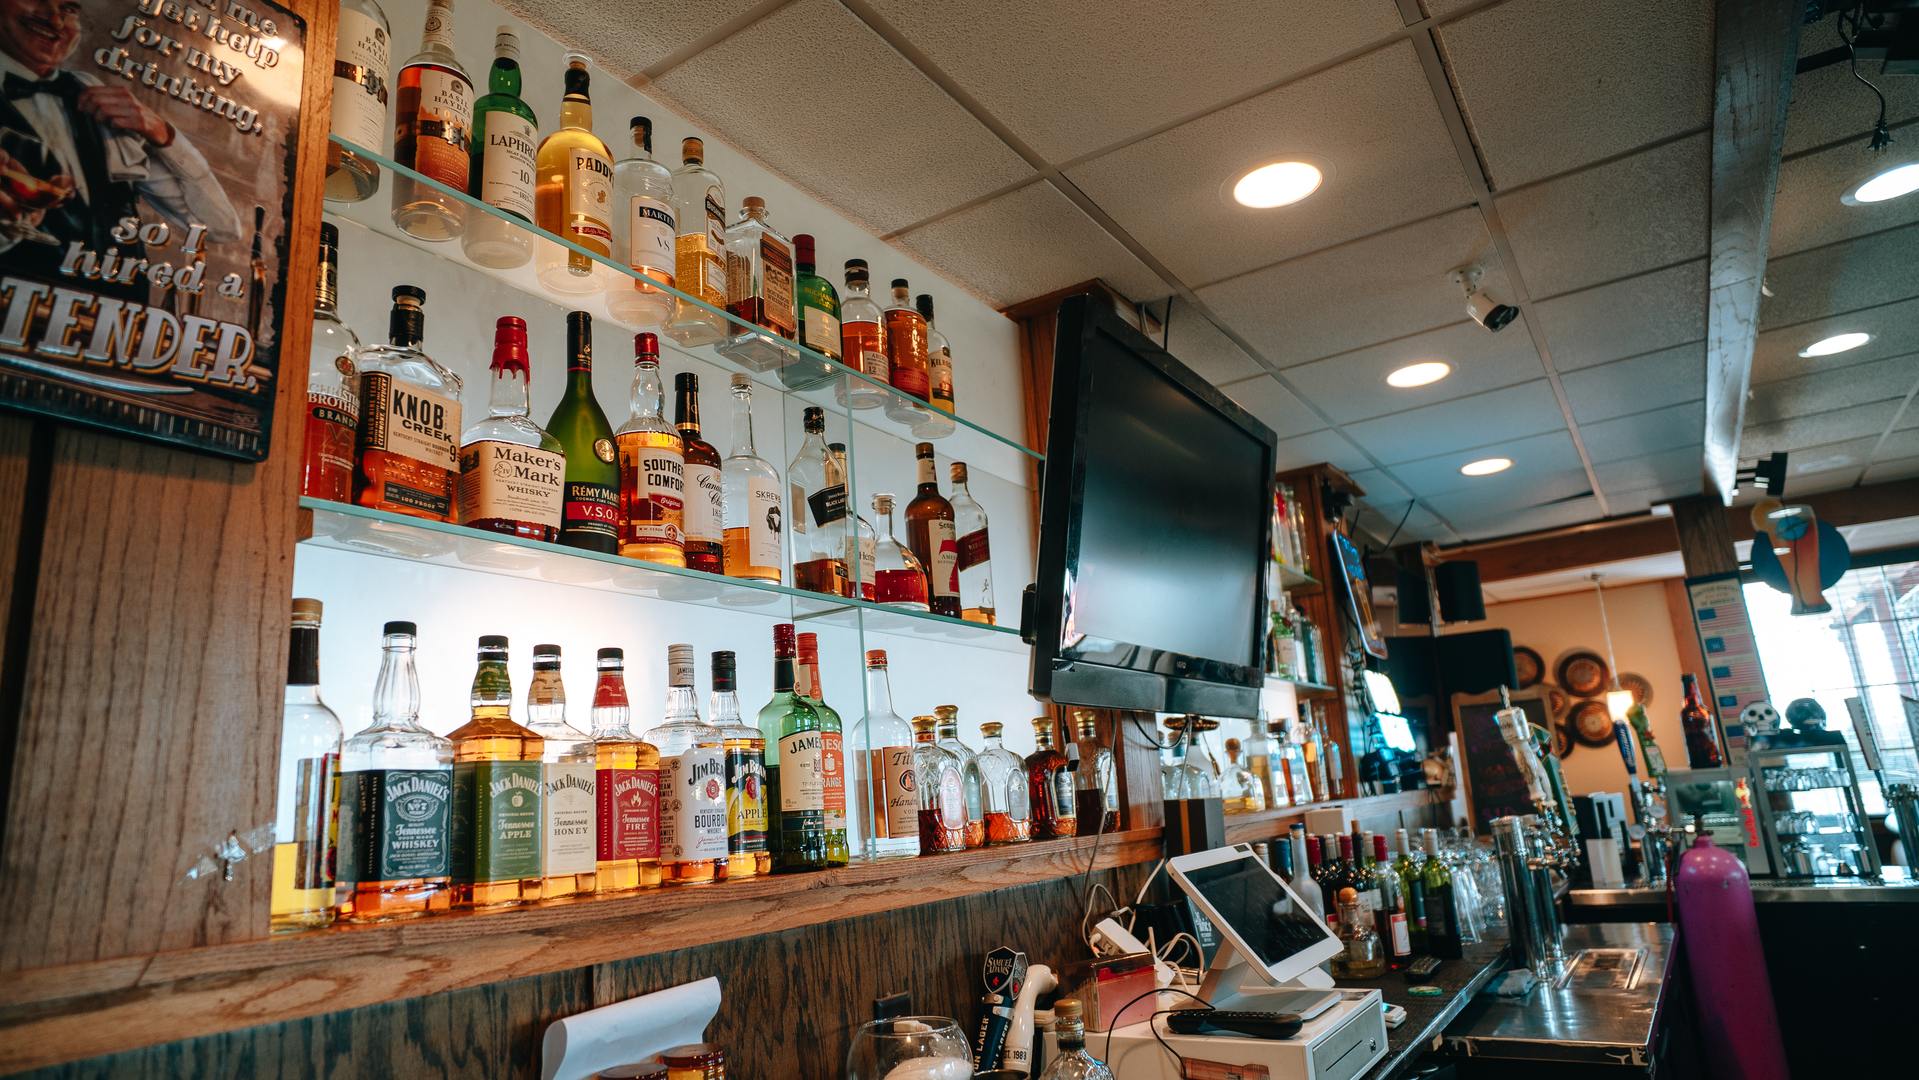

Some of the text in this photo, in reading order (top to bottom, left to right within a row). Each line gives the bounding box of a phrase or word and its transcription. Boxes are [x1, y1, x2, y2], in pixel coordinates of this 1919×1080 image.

[225, 0, 279, 37] me
[137, 0, 279, 69] get help
[110, 15, 243, 86] for my
[365, 36, 388, 59] BASIL
[93, 46, 263, 134] drinking,
[441, 90, 464, 110] BASIL
[519, 169, 530, 185] 10
[110, 216, 208, 254] so I
[656, 236, 671, 252] VS
[59, 240, 244, 301] hired a
[369, 376, 377, 398] YEARS
[318, 409, 357, 430] BRANDY
[377, 377, 388, 446] CLERMONT, KENTUCKY
[393, 388, 444, 431] KNOB
[325, 422, 351, 447] VS
[402, 419, 453, 444] CREEK
[393, 431, 457, 463] KENTUCKY STRAIGHT BOURBON 9
[425, 447, 444, 457] WHISKEY
[384, 458, 415, 474] KNOB
[493, 446, 561, 471] Maker's
[513, 465, 560, 487] Mark
[506, 484, 551, 498] WHISKY
[571, 485, 600, 498] RÉMY
[401, 496, 436, 509] 100 PROOF
[660, 496, 681, 508] Original
[825, 499, 838, 507] BLACK
[688, 762, 708, 786] JIM
[731, 758, 766, 784] JIM BEAM
[386, 776, 450, 802] JACK DANIEL'S
[488, 776, 511, 798] JACK
[545, 773, 595, 797] JACK DANIEL'S
[614, 776, 658, 797] JACK DANIEL'S
[497, 819, 535, 830] Tennessee
[554, 817, 588, 827] Tennessee
[622, 813, 650, 824] Tennessee
[737, 808, 767, 820] APPLE
[395, 823, 437, 836] Tennessee
[499, 830, 532, 840] APPLE
[554, 827, 588, 836] HONEY
[626, 823, 647, 831] FIRE
[391, 839, 440, 849] WHISKEY
[986, 965, 1009, 976] ADAMS
[987, 957, 1013, 969] SAMUEL
[976, 1017, 989, 1052] LAGER
